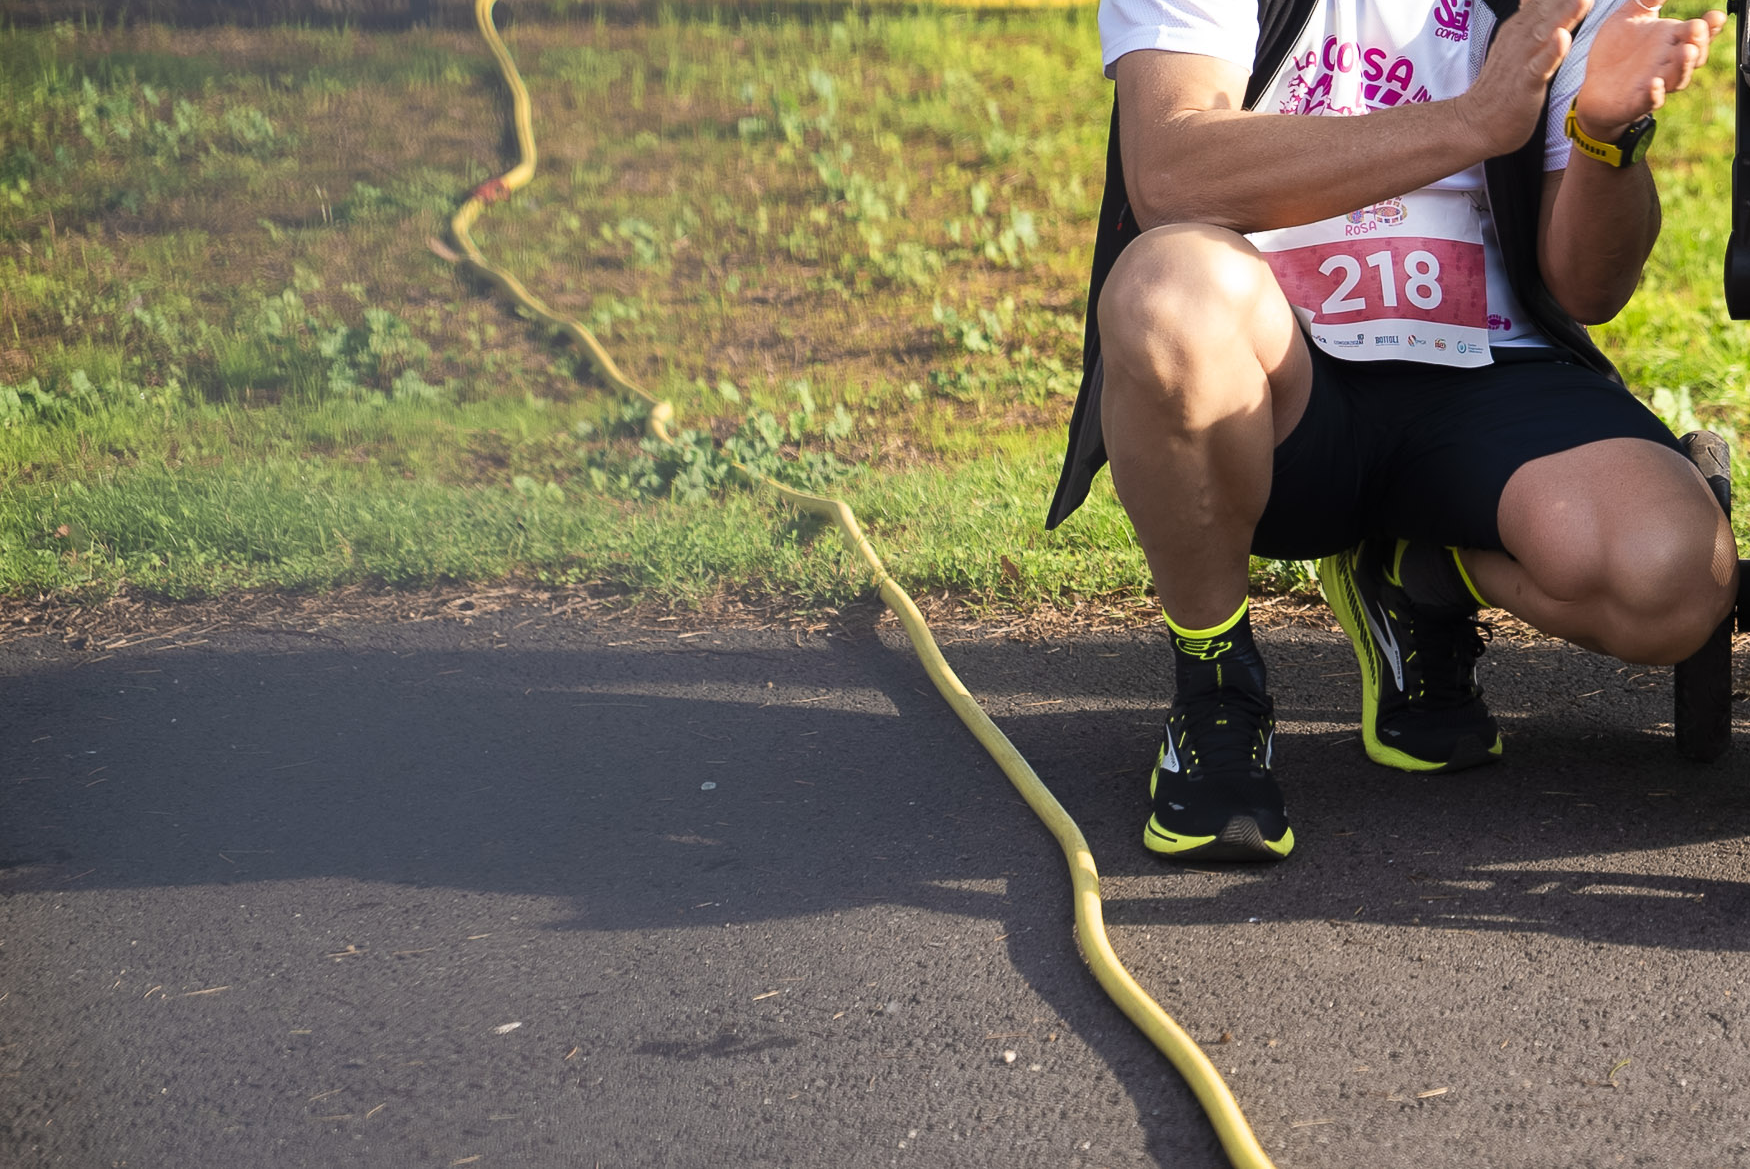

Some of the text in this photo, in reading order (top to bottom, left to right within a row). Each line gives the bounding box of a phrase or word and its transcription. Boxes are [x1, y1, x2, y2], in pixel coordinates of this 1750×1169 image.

[1292, 34, 1414, 91] LA COSA
[1345, 220, 1377, 236] ROSA
[1318, 250, 1443, 314] 218
